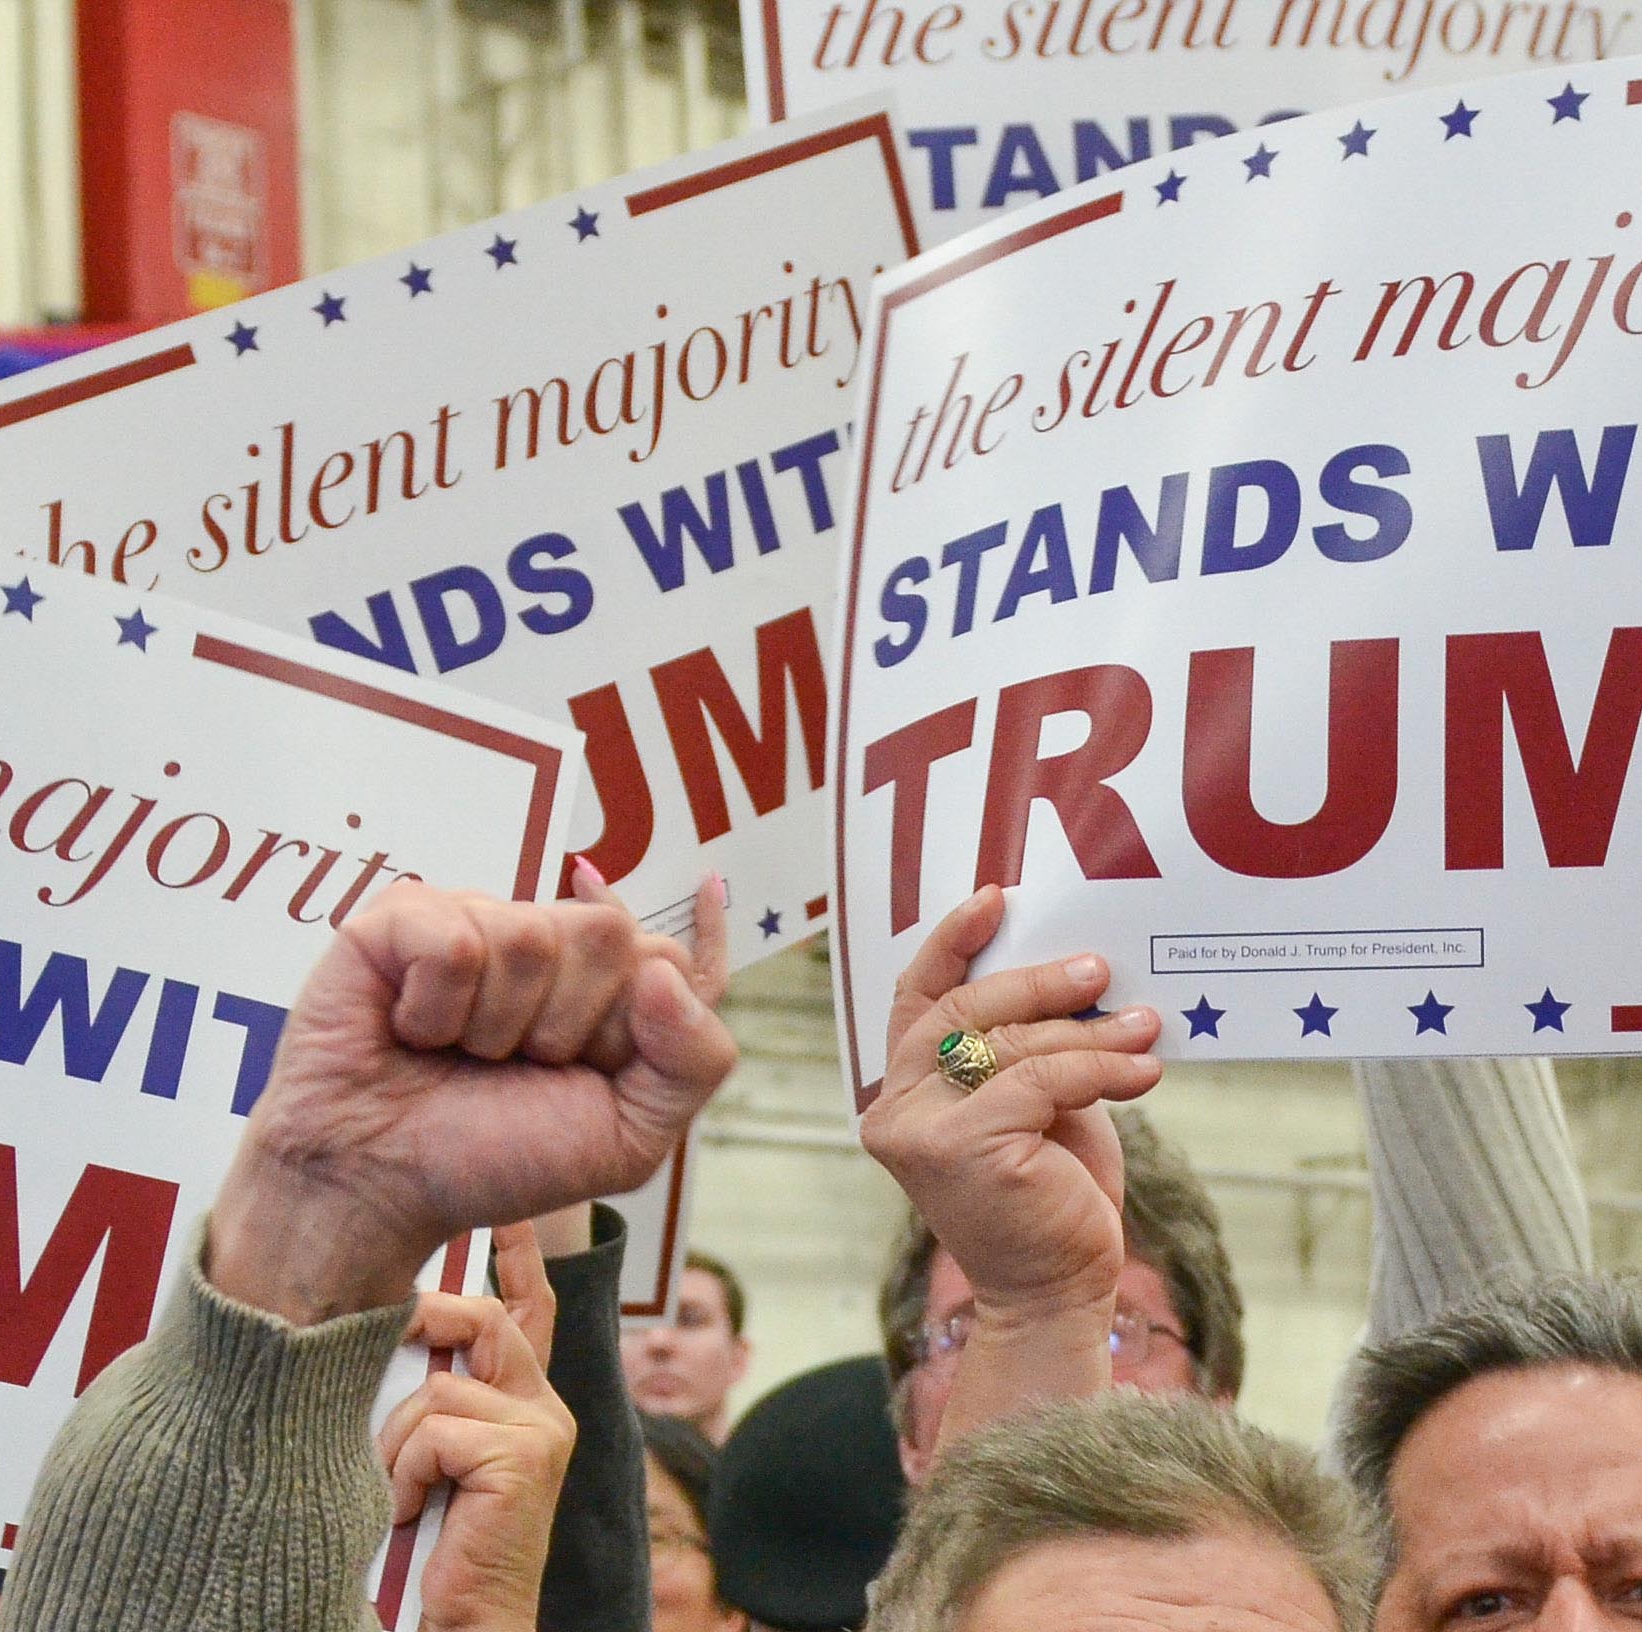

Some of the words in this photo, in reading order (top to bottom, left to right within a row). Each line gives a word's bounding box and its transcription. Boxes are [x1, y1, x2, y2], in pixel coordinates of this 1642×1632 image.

[813, 0, 960, 70] the
[981, 0, 1239, 76] silent
[1270, 0, 1630, 82] majority
[16, 502, 158, 591] he
[185, 404, 462, 574] silent
[491, 262, 883, 463] majority
[889, 352, 1025, 494] the
[1031, 277, 1343, 434] silent
[618, 424, 853, 592] WIT
[873, 444, 1413, 669] STANDS
[1167, 946, 1198, 960] Paid
[1201, 946, 1217, 959] for
[1221, 946, 1237, 961] by
[1240, 944, 1287, 958] Donald
[1290, 944, 1302, 958] J.
[1306, 943, 1347, 958] Trump
[1351, 943, 1367, 955] for
[1371, 942, 1438, 956] President,
[1442, 941, 1466, 954] Inc.
